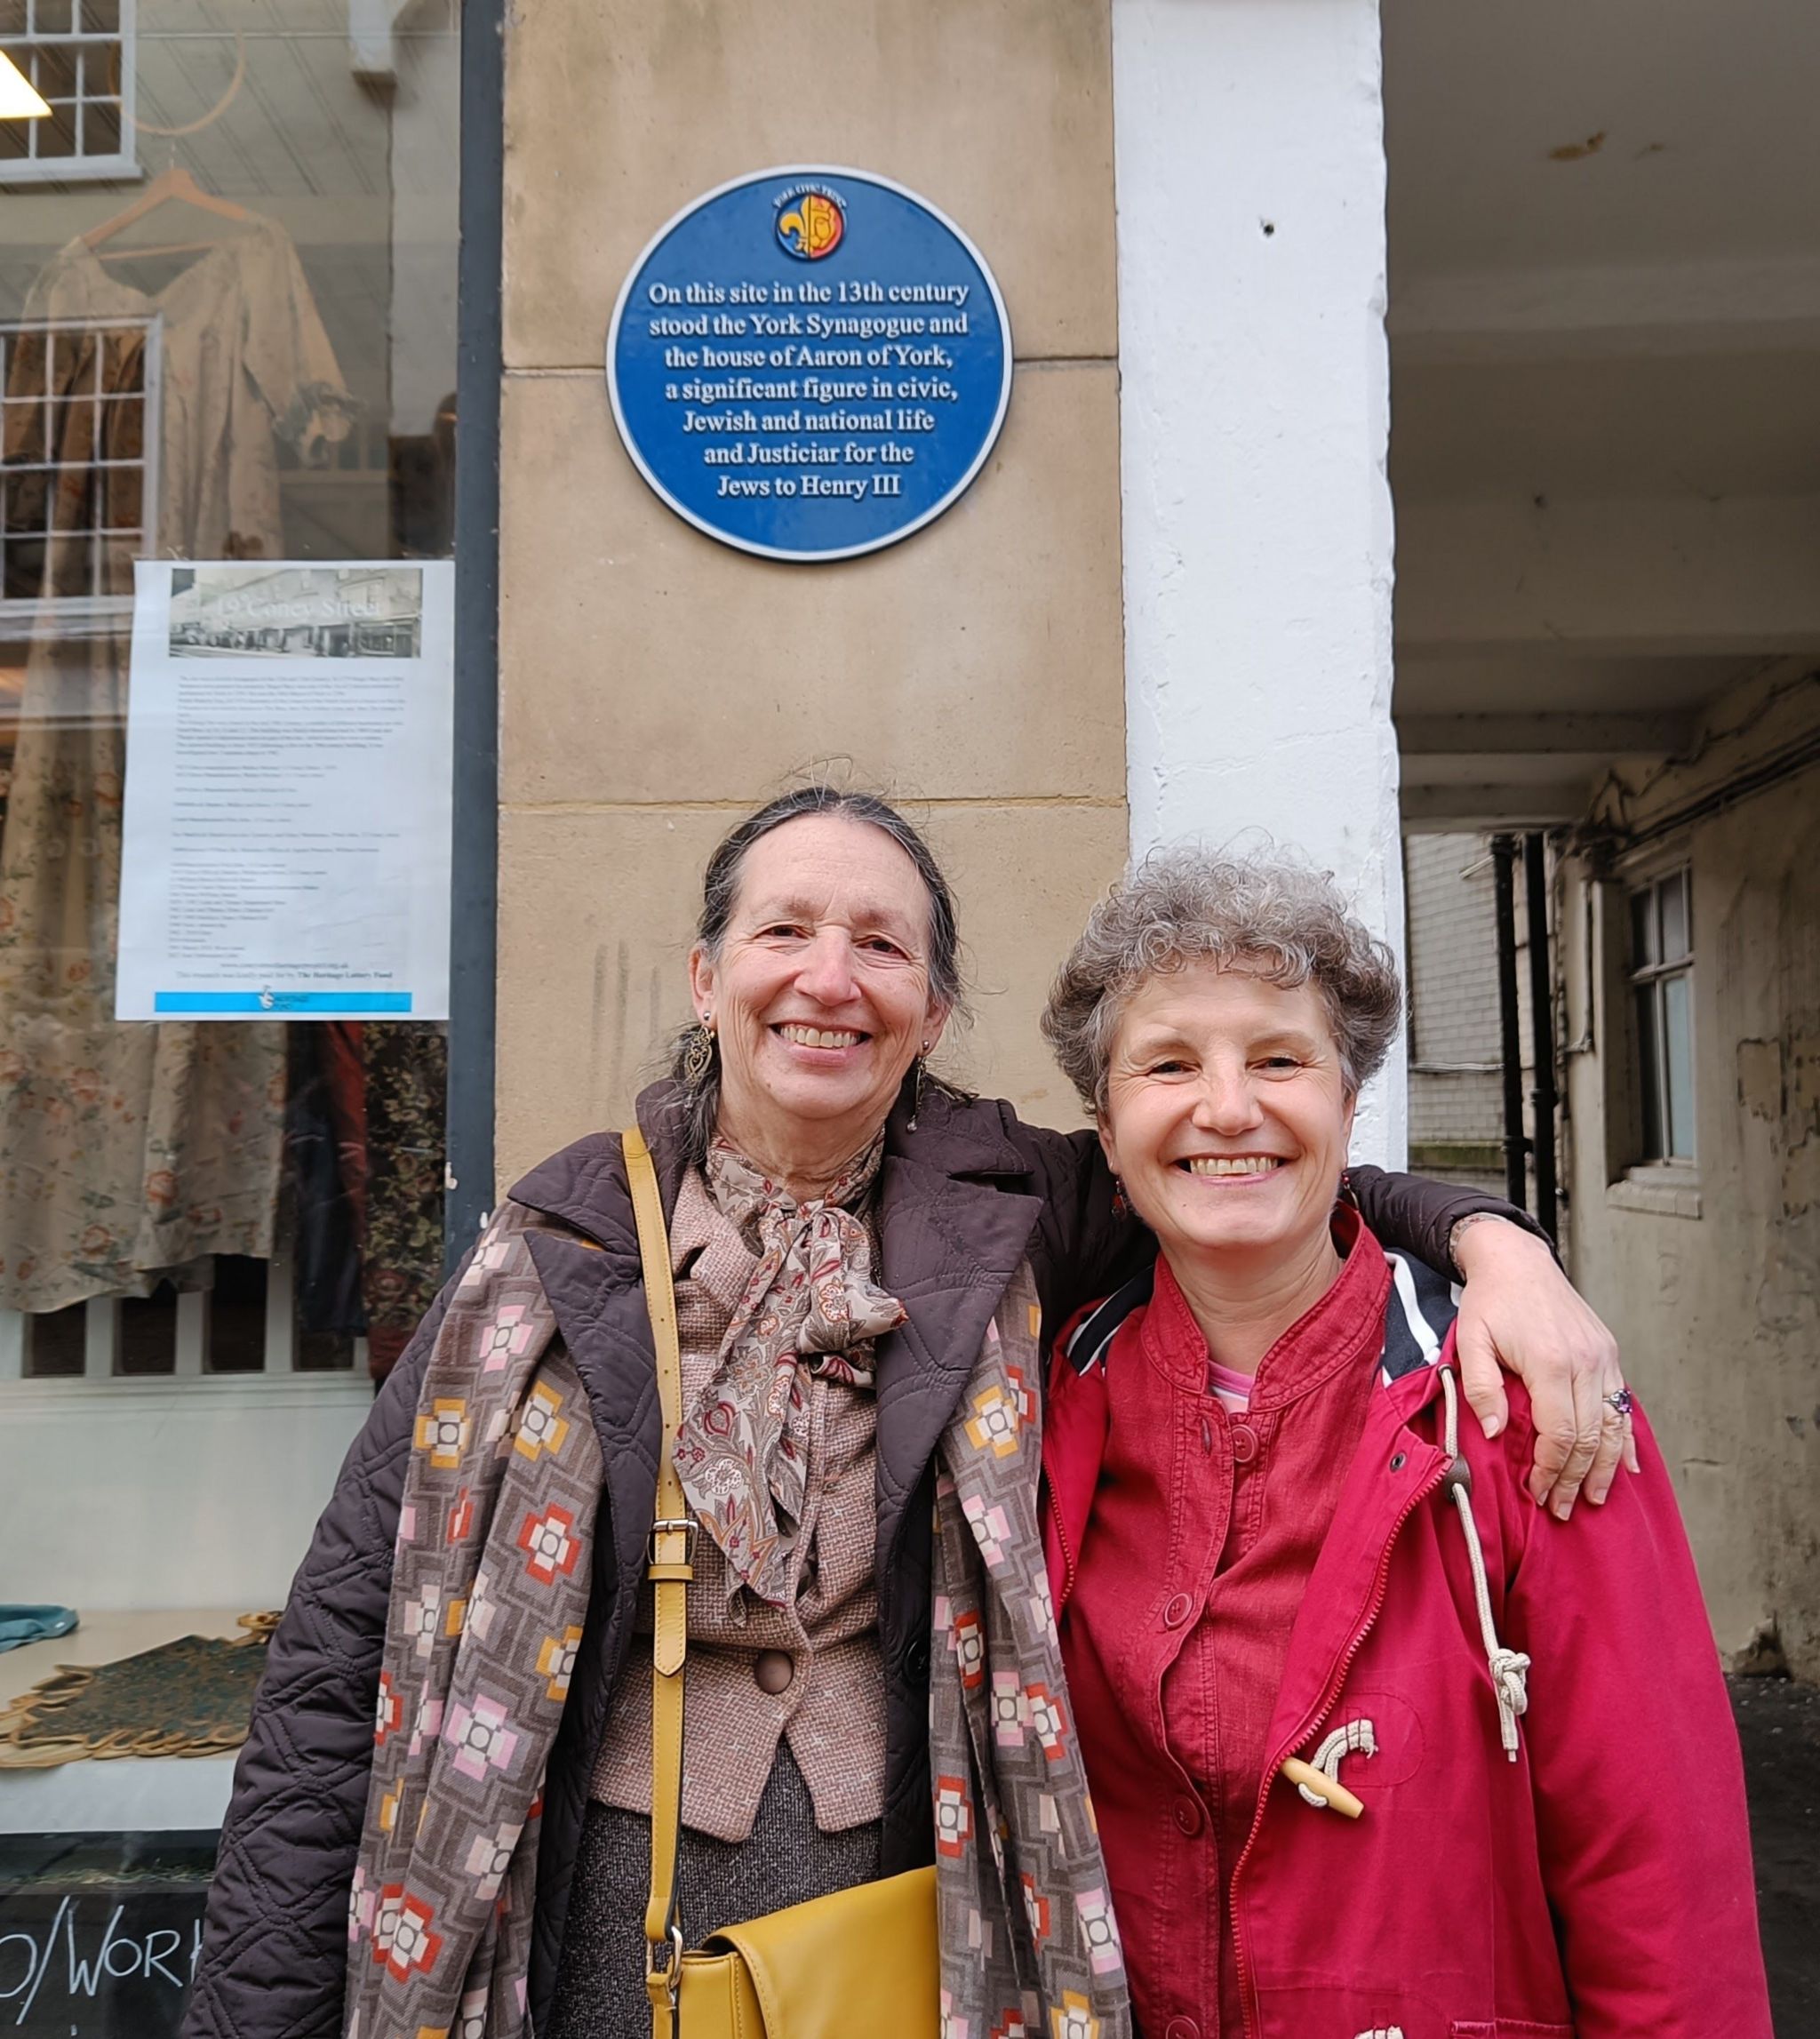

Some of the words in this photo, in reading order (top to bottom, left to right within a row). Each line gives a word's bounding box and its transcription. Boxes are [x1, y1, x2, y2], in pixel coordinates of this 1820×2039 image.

[649, 283, 681, 304] On
[685, 281, 726, 304] this
[730, 281, 767, 303] site
[772, 281, 794, 303] in
[799, 280, 832, 303] the
[838, 280, 883, 303] 13th
[889, 284, 969, 306] century
[649, 314, 708, 336] stood
[713, 314, 746, 335] the
[749, 313, 801, 335] York
[806, 314, 925, 338] Synagogue
[929, 312, 969, 334] and
[665, 346, 698, 368] the
[702, 346, 765, 367] house
[769, 345, 797, 367] of
[797, 347, 862, 367] Aaron
[867, 345, 892, 366] of
[892, 345, 953, 369] York,
[666, 383, 678, 400] a
[682, 377, 798, 404] significant
[802, 377, 866, 403] figure
[873, 377, 894, 399] in
[898, 377, 959, 402] civic,
[682, 410, 757, 433] Jewish
[762, 410, 800, 432] and
[804, 410, 890, 431] national
[896, 409, 936, 431] life
[704, 443, 743, 464] and
[746, 443, 839, 465] Justiciar
[843, 442, 876, 464] for
[880, 442, 914, 463] the
[716, 475, 770, 498] Jews
[774, 476, 797, 497] to
[800, 474, 867, 500] Henry
[871, 474, 902, 496] III
[322, 596, 381, 617] Street
